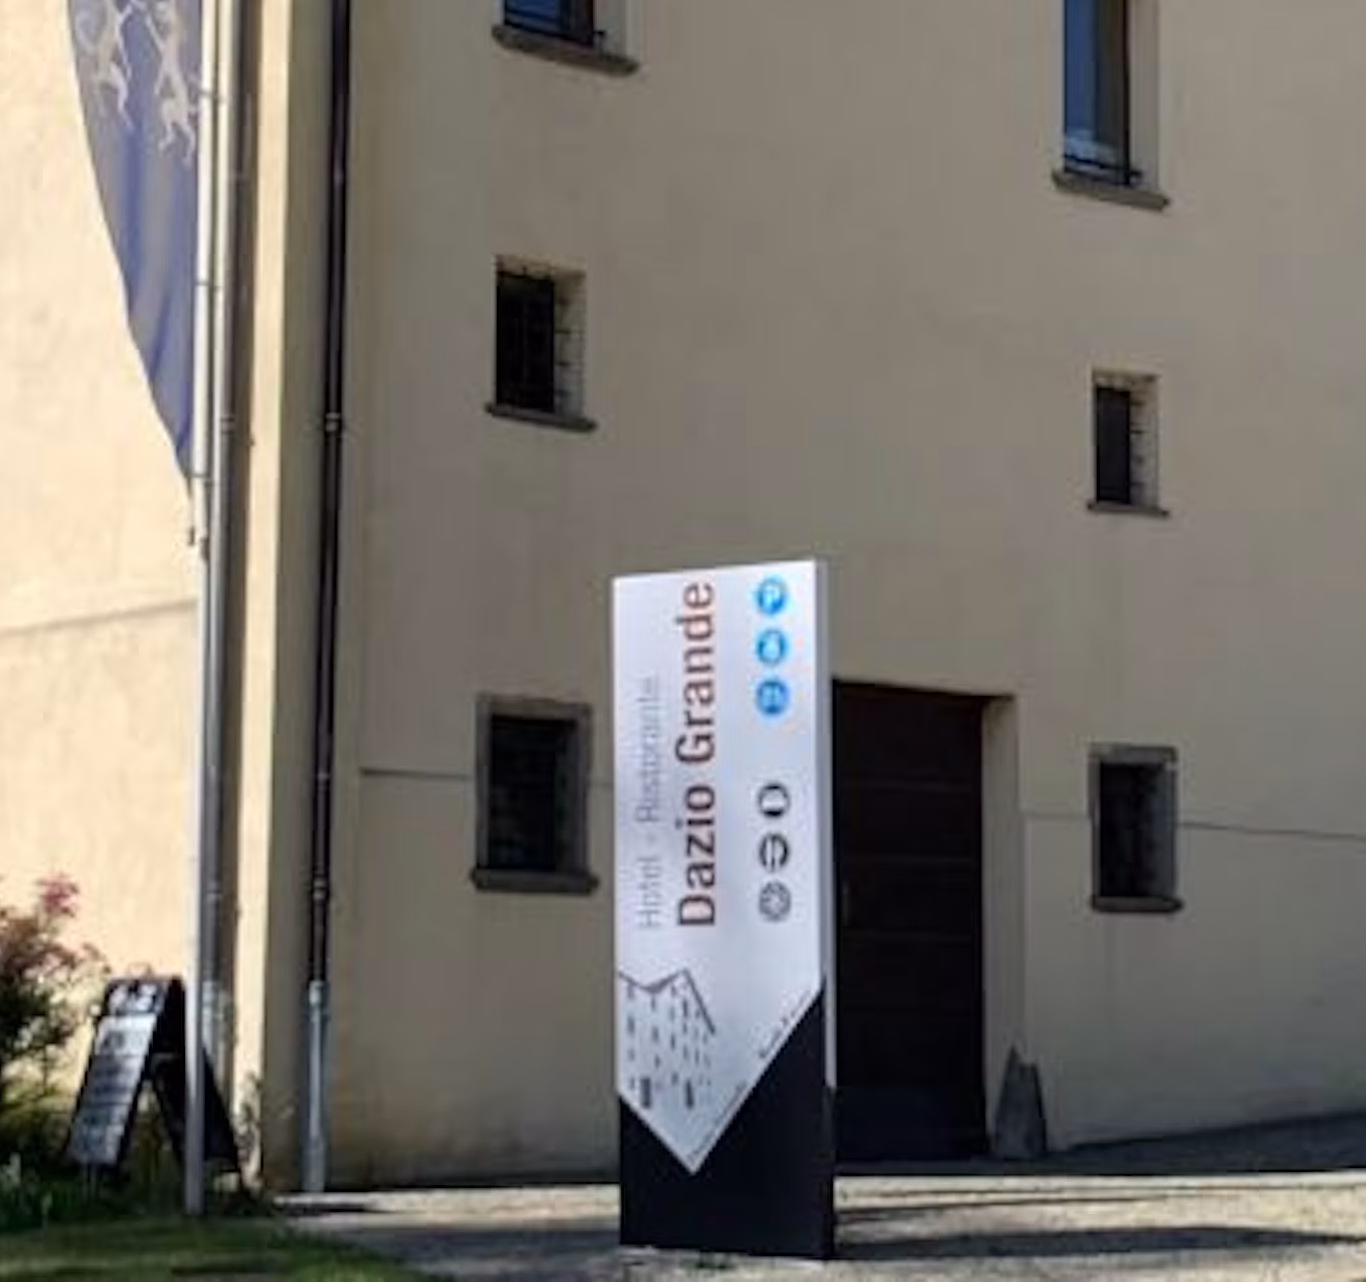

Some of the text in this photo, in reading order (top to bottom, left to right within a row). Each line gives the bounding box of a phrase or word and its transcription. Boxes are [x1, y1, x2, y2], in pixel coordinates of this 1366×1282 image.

[634, 674, 660, 822] Ristorante
[673, 582, 716, 926] Dazio Grande
[636, 855, 661, 929] Hotel
